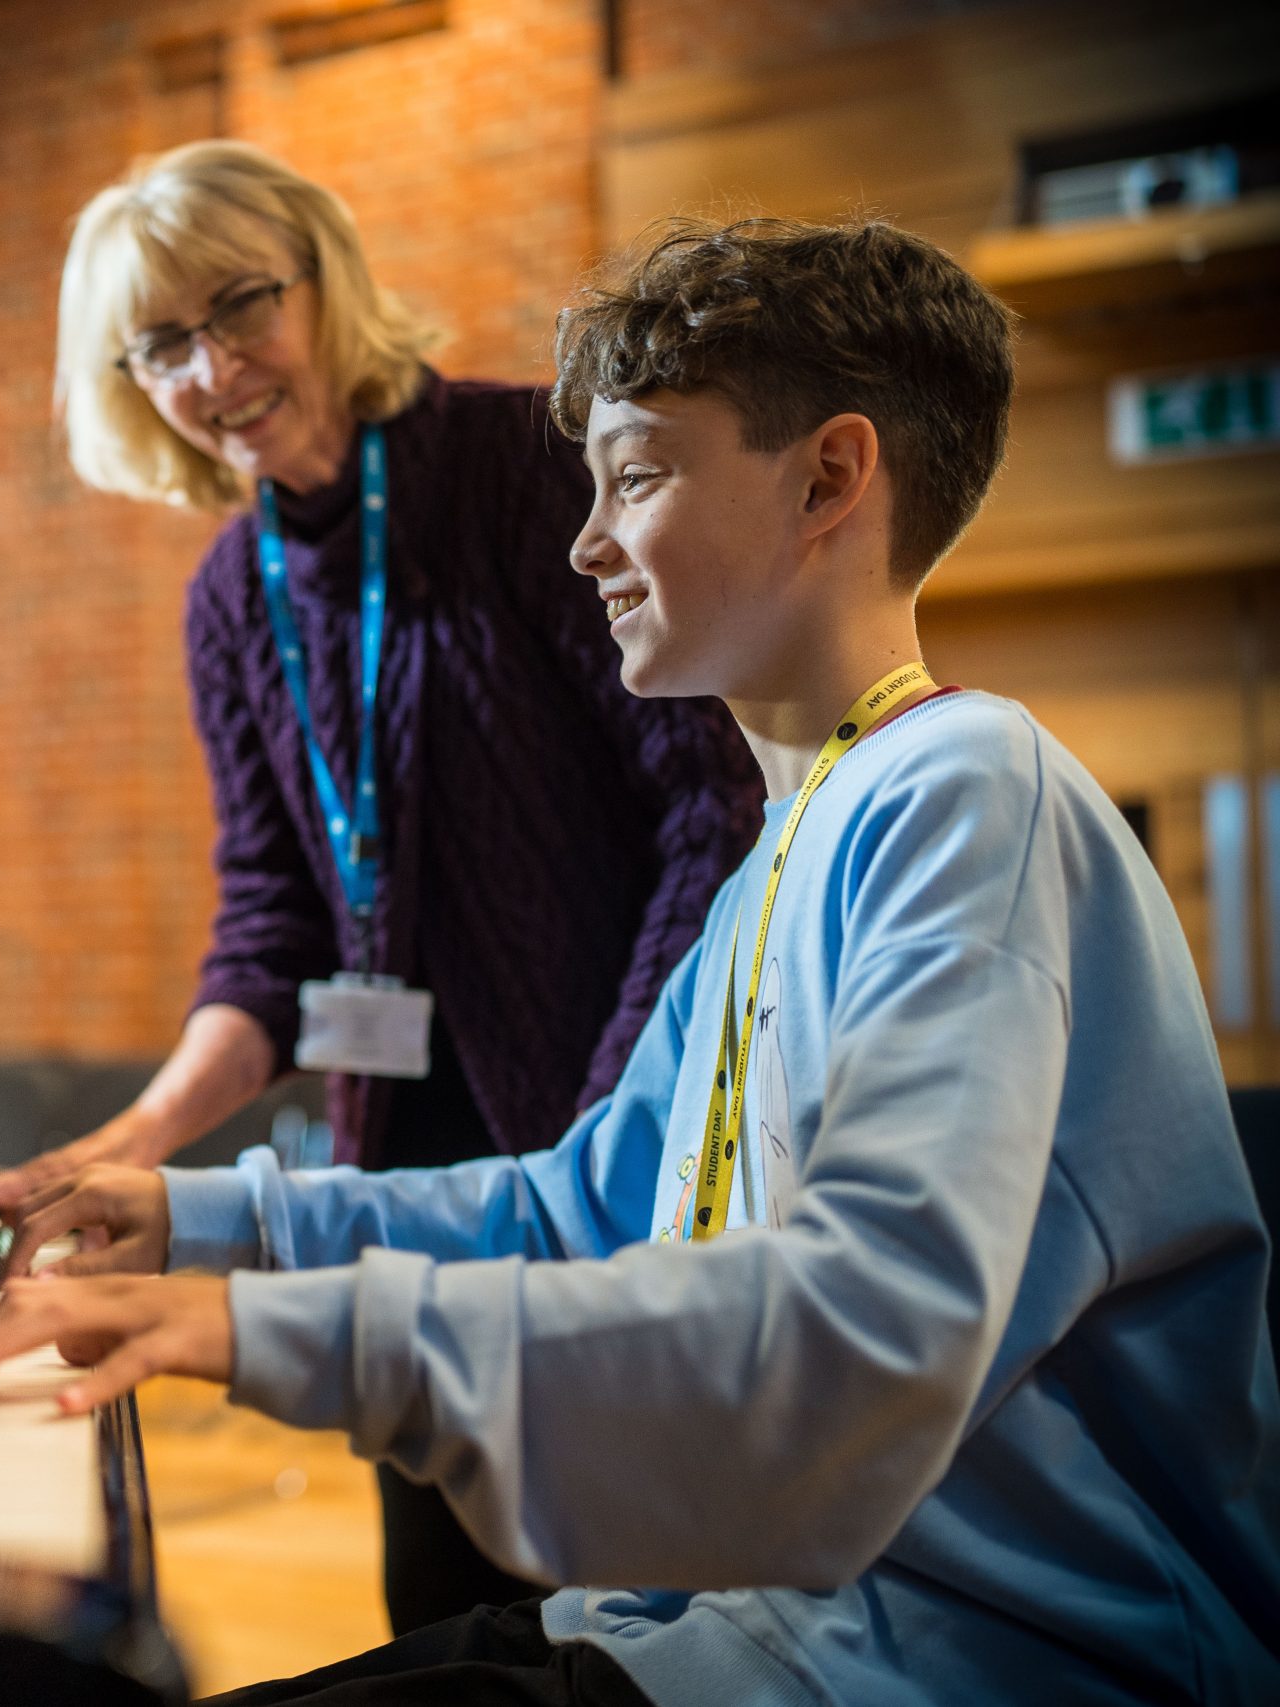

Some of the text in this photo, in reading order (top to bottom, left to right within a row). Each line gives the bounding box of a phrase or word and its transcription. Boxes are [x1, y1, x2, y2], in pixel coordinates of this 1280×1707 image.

[866, 670, 921, 709] STUDENT DAY
[798, 758, 830, 805] STUDENT
[732, 1039, 747, 1119] STUDENT DAY
[706, 1109, 722, 1187] STUDENT DAY
